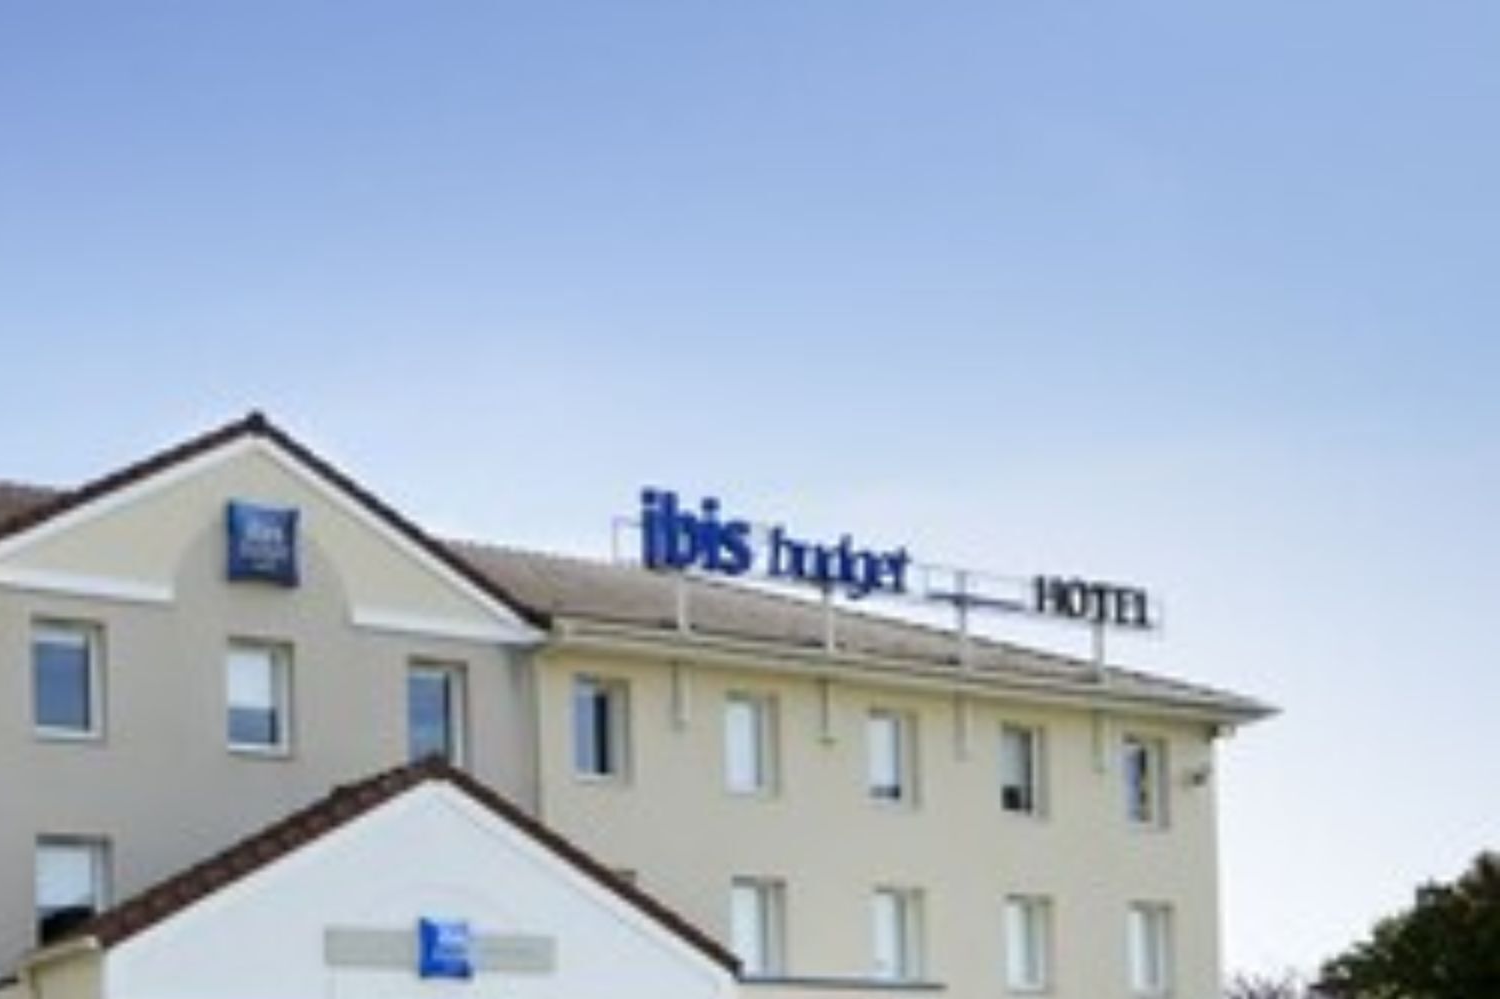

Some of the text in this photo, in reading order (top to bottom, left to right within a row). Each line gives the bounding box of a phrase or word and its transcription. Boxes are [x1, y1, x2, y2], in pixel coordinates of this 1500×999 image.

[641, 486, 1151, 629] ibis budget HOTEL
